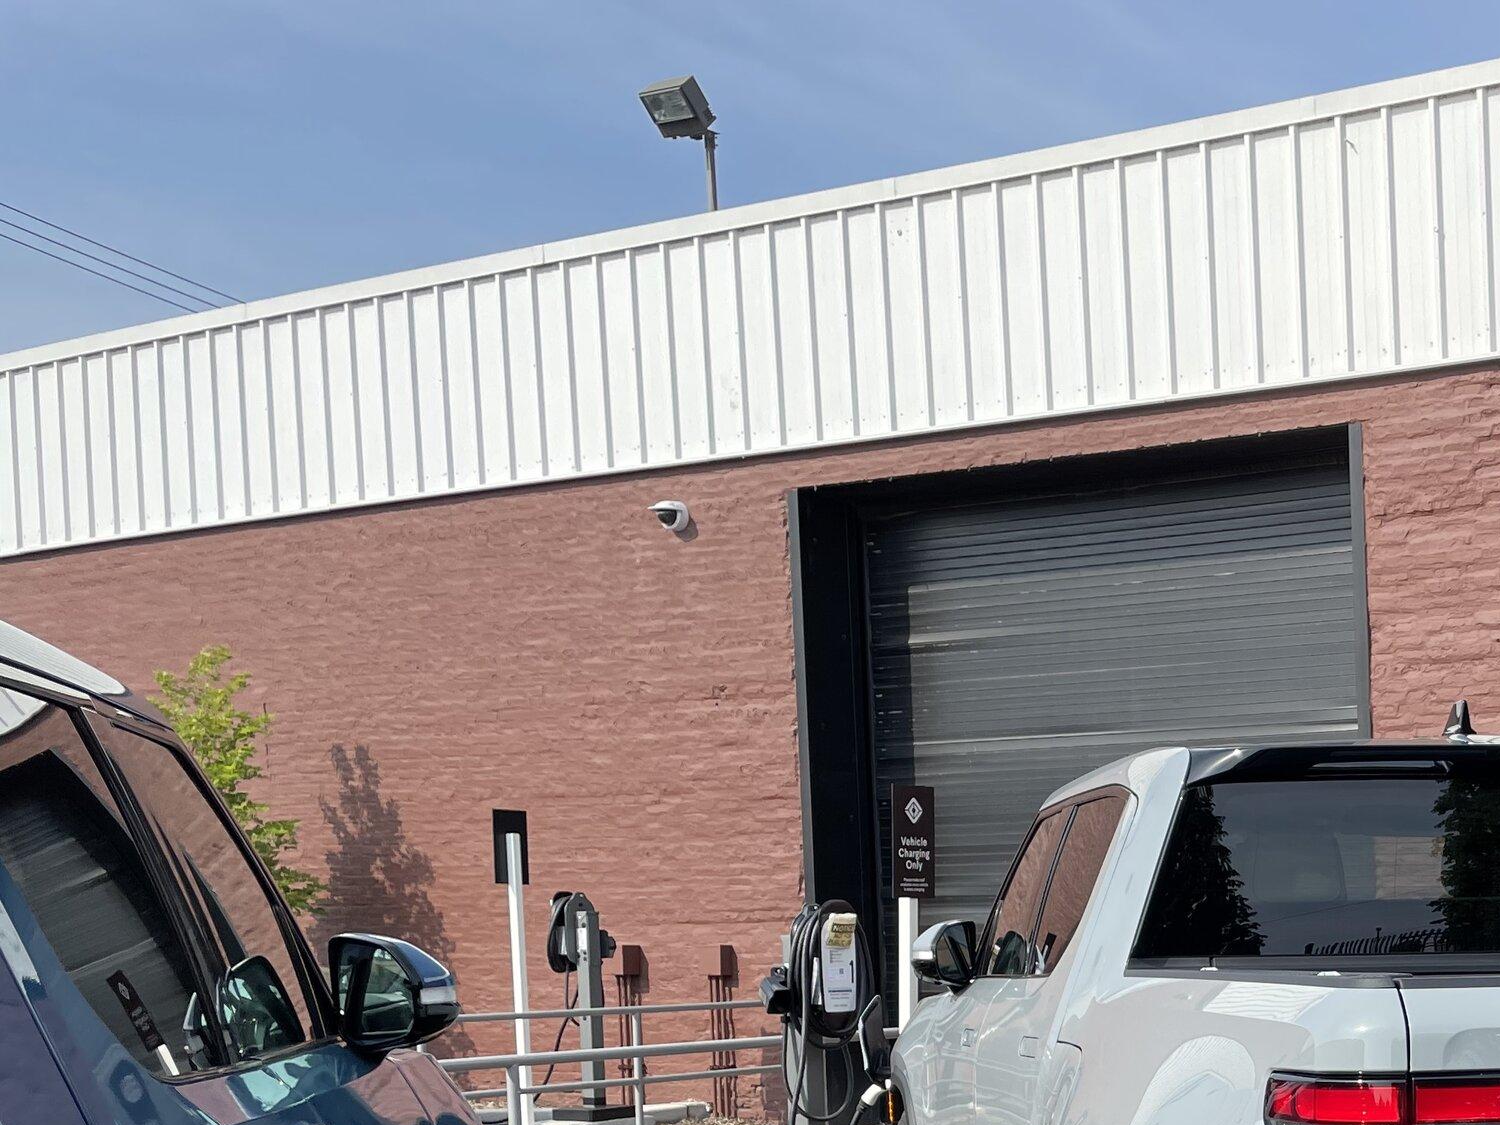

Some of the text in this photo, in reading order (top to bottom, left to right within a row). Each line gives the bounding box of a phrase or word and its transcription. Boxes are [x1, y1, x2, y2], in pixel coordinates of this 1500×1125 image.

[901, 836, 928, 846] Vehicle
[898, 848, 931, 860] Charging
[905, 860, 923, 872] Only
